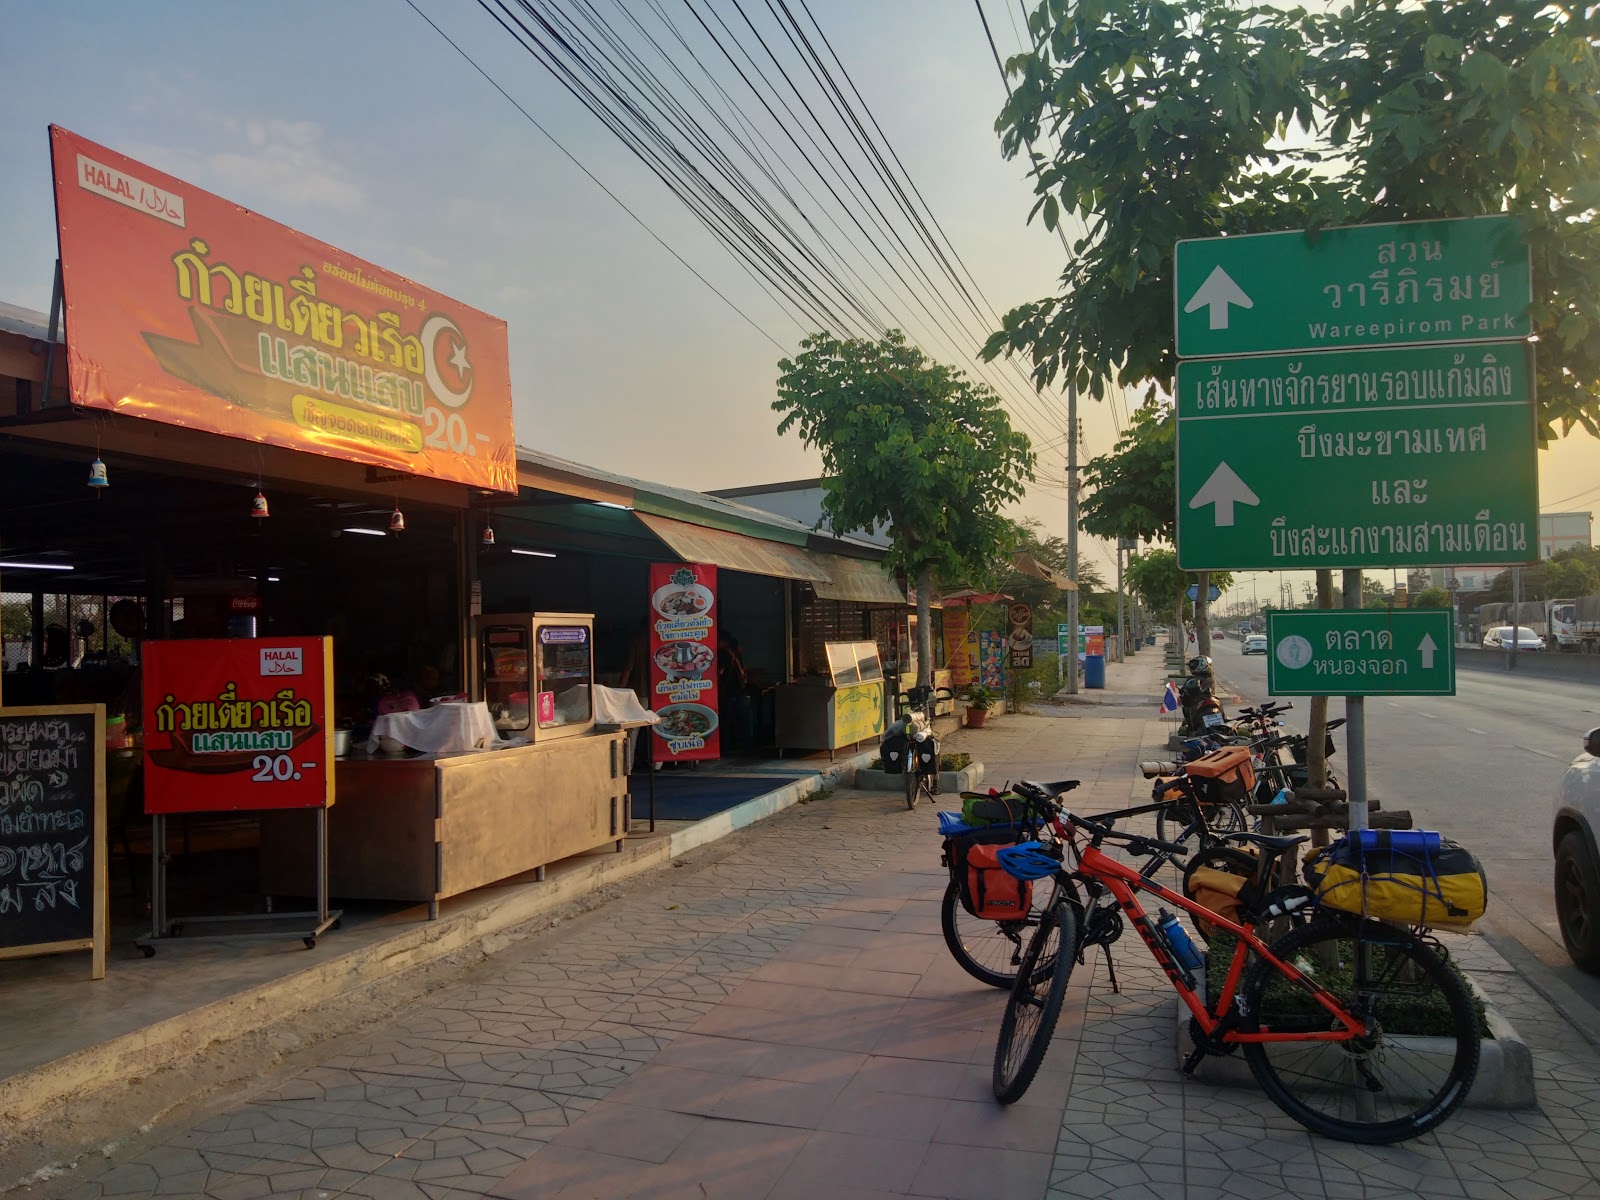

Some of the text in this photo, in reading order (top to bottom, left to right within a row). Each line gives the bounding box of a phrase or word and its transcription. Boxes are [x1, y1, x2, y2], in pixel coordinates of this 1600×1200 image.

[84, 163, 135, 200] HALAL
[1377, 239, 1443, 264] สวน
[1323, 260, 1504, 308] วารีภิรมย์
[173, 240, 425, 375] ก๋วยเตี๋ยวเรือ
[1309, 313, 1516, 340] Wareepirom Park
[257, 331, 425, 417] แสนแสบ
[1196, 353, 1513, 409] เส้นทางจักรยานรอบแก้มลิง
[424, 406, 490, 456] 20.-
[1297, 423, 1487, 459] บึงมะขามเทศ
[1371, 478, 1429, 505] และ
[1270, 509, 1528, 558] บึงสะแกงามสามเดือน
[1325, 627, 1393, 650] ตลาด
[264, 651, 298, 661] HALAL
[1012, 656, 1030, 667] สด
[1313, 658, 1408, 676] หนองจอก
[155, 682, 313, 733] ก๋วยเตี๋ยวเรือ
[192, 730, 293, 754] แสนแสบ
[252, 755, 317, 782] 20.-
